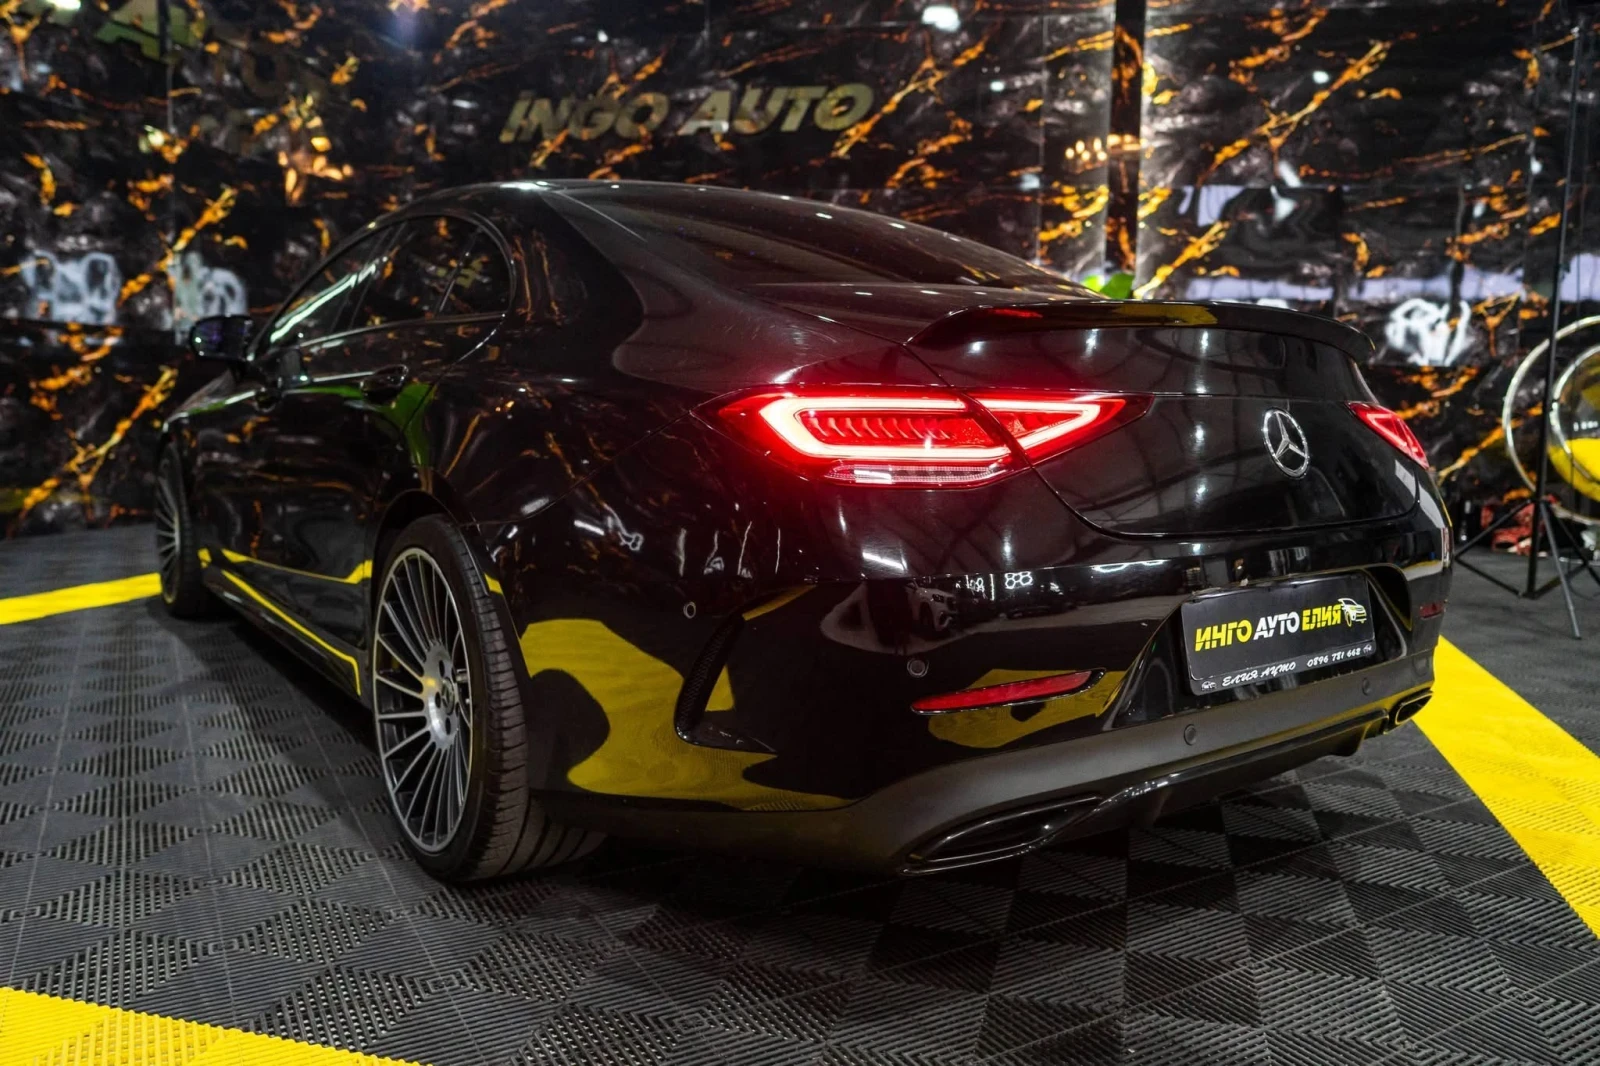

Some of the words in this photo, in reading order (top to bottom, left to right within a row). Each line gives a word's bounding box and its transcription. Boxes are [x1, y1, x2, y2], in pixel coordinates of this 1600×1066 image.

[500, 88, 669, 143] INGO
[677, 83, 874, 136] AUTO
[1195, 619, 1253, 652] ИНГО
[1253, 611, 1300, 640] АУТО
[1302, 603, 1342, 631] ЕЛИЯ
[1306, 654, 1329, 668] 0896
[1331, 651, 1345, 662] 781
